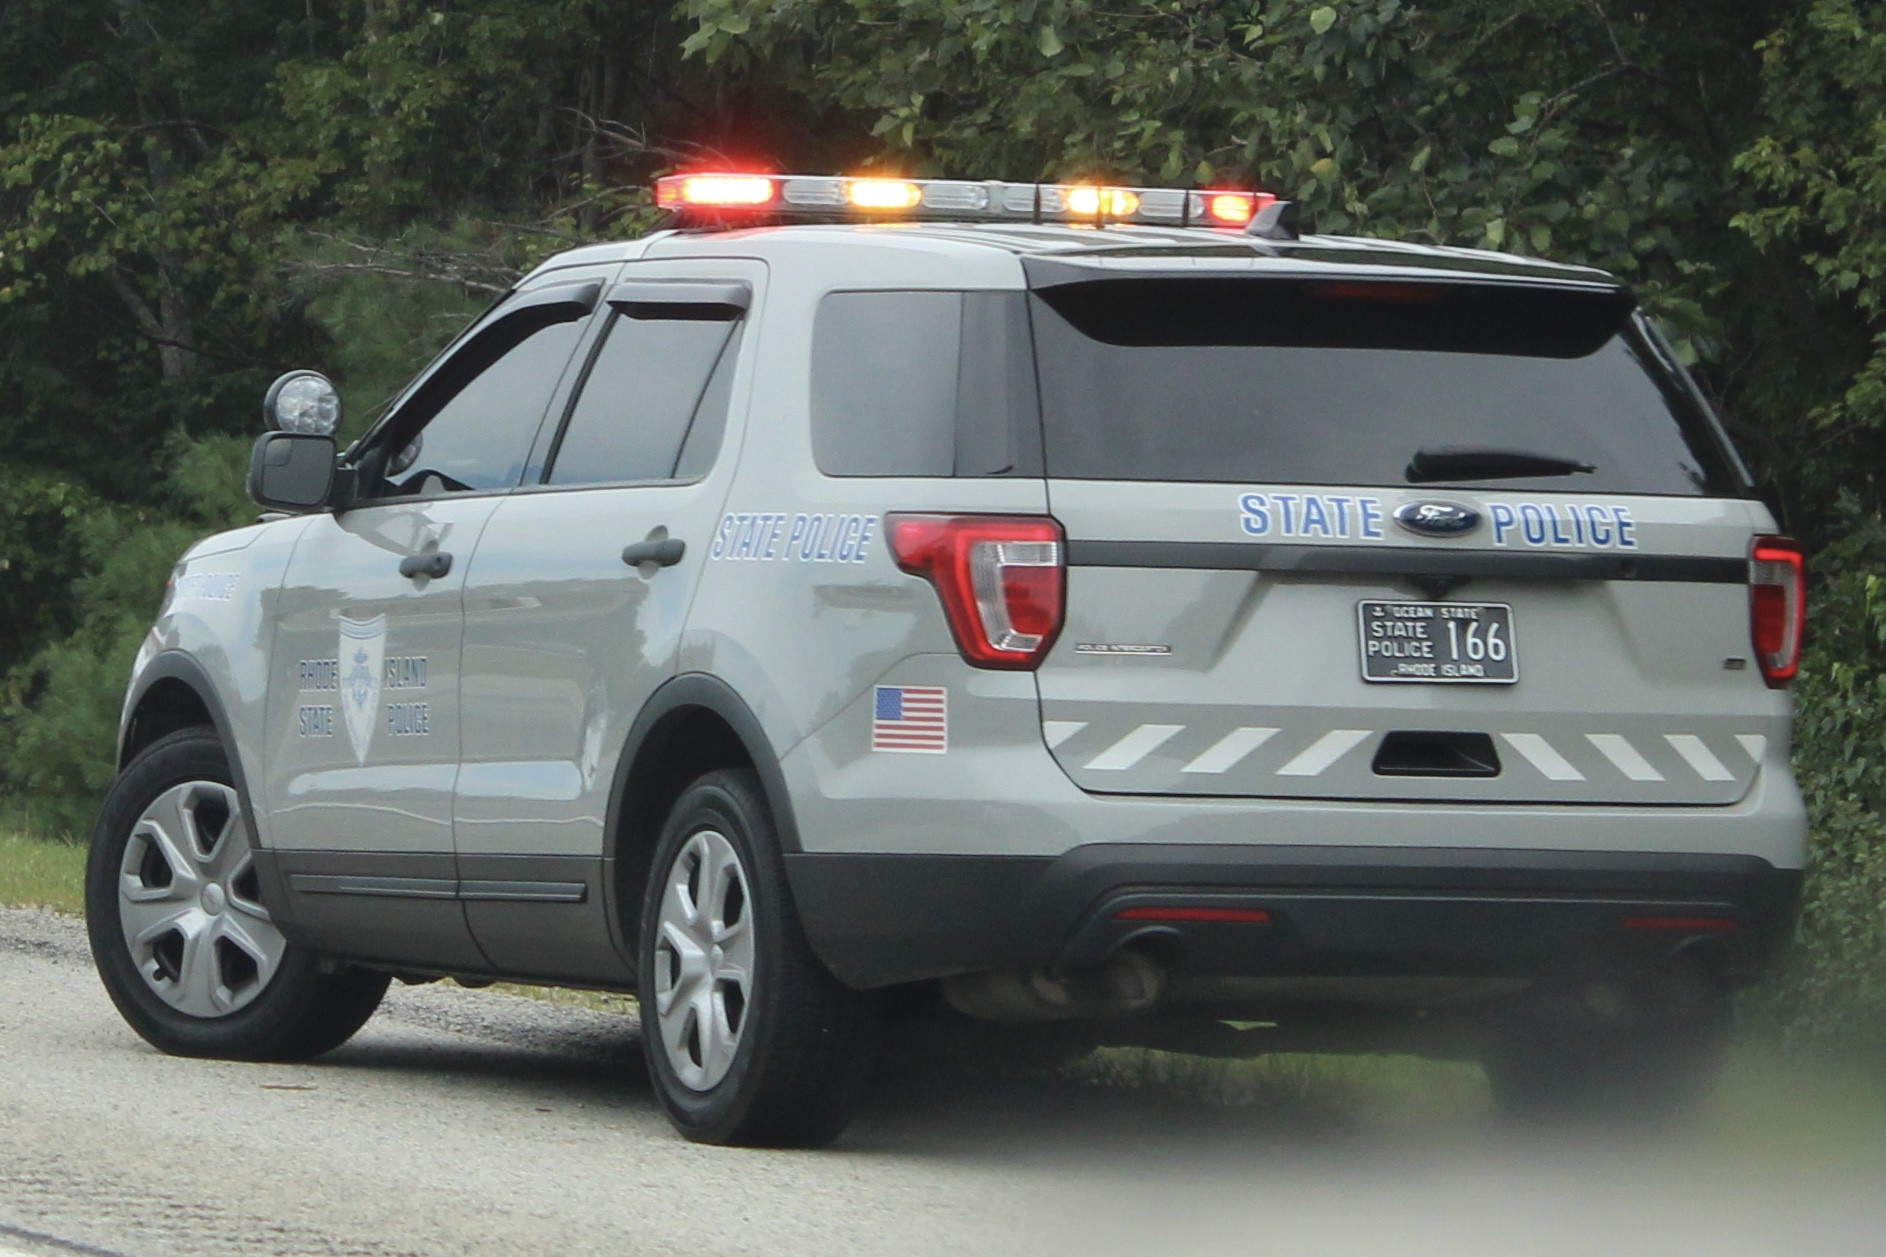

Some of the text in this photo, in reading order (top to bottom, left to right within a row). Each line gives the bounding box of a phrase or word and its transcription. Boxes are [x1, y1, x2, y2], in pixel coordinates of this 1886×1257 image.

[1239, 492, 1639, 550] STATE POLICE
[711, 512, 879, 564] STATE POLICE
[1393, 606, 1479, 620] OCEAN STATE
[1371, 621, 1428, 639] STATE
[1447, 621, 1507, 662] 166
[1368, 640, 1435, 658] POLICE
[1398, 664, 1485, 677] RHODE ISLAND
[299, 702, 429, 738] STATE POLICE
